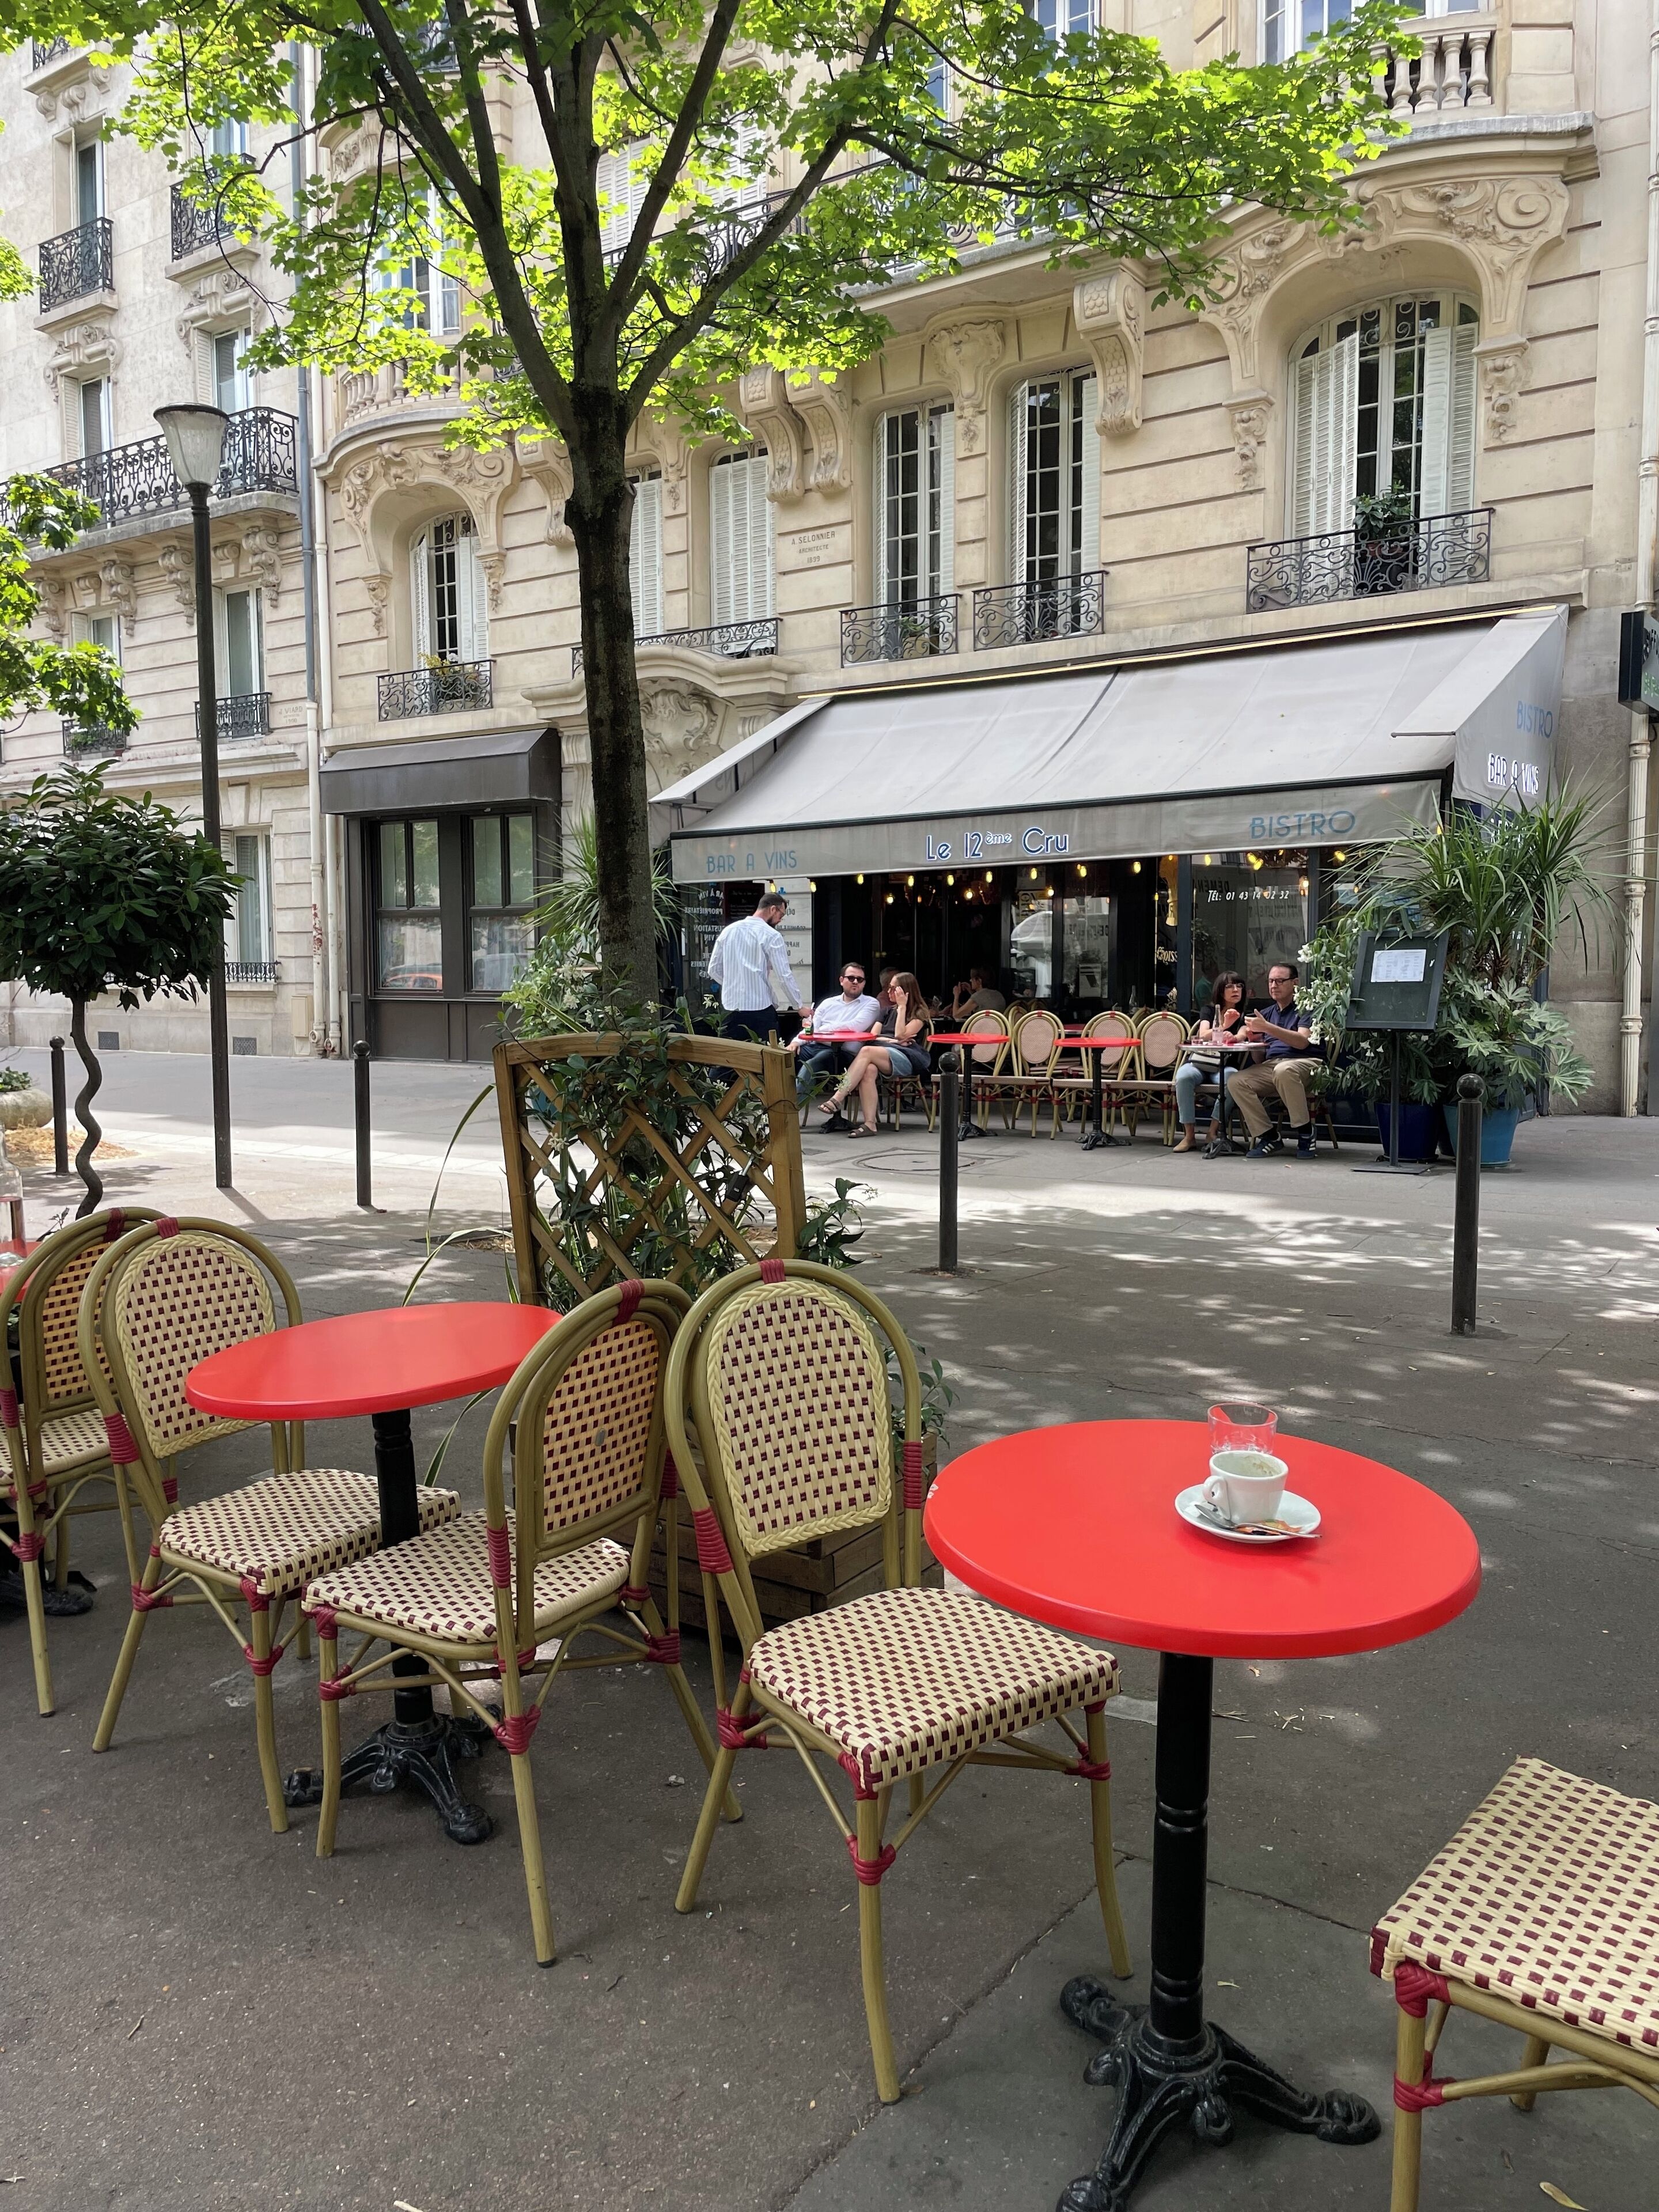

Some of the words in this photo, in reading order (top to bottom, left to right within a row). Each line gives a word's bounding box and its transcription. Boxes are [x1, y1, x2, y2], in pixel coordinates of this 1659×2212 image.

[798, 531, 836, 544] SELONNIER
[798, 544, 830, 554] ARCHITECTE
[807, 555, 820, 563] 1899
[285, 706, 303, 714] VIARD
[1516, 700, 1554, 738] BISTRO
[1488, 753, 1508, 786] BAR
[1521, 763, 1539, 795] VINS
[1249, 810, 1356, 839] BISTRO
[927, 835, 952, 861] Le
[1022, 827, 1069, 854] Cru
[706, 855, 736, 873] BAR
[746, 853, 755, 871] A
[764, 850, 797, 870] VINS
[1226, 892, 1235, 900] 01
[1238, 892, 1248, 900] 43
[1253, 891, 1262, 900] 14
[1279, 891, 1289, 899] 32
